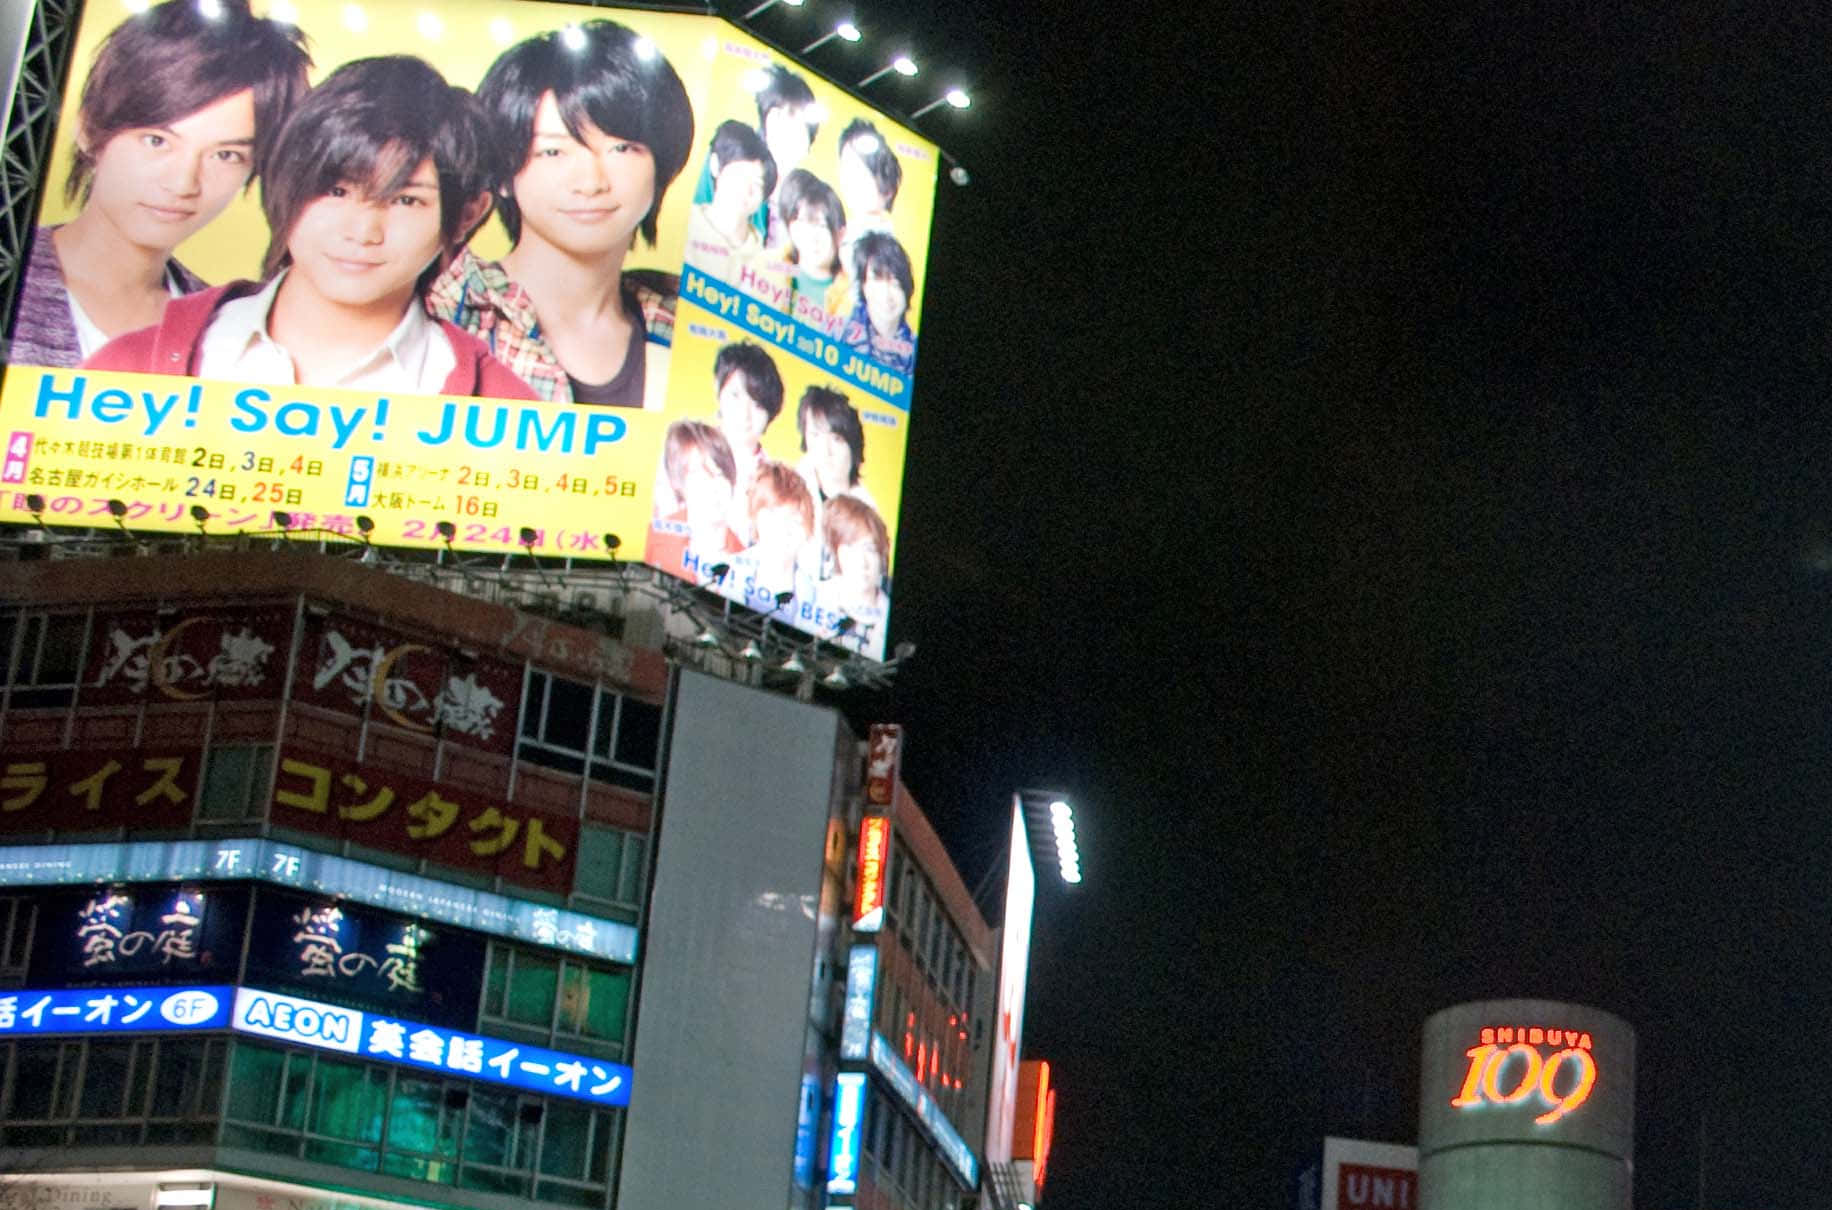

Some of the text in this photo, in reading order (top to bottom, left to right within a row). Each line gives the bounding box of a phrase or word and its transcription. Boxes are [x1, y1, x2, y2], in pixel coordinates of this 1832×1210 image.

[686, 271, 741, 317] Hey!
[745, 303, 795, 345] Say!
[843, 352, 905, 397] JUMP
[34, 373, 628, 457] Hey! Say! JUMP
[276, 756, 567, 872] コンタクト
[215, 849, 242, 870] 7F
[271, 852, 301, 877] 7F
[172, 998, 207, 1020] 6F
[245, 996, 351, 1046] AEON
[368, 1019, 622, 1097] 英会話イーオン
[1480, 1026, 1594, 1051] SHIBUYA
[1451, 1042, 1598, 1126] 109
[1346, 1172, 1410, 1210] UNI
